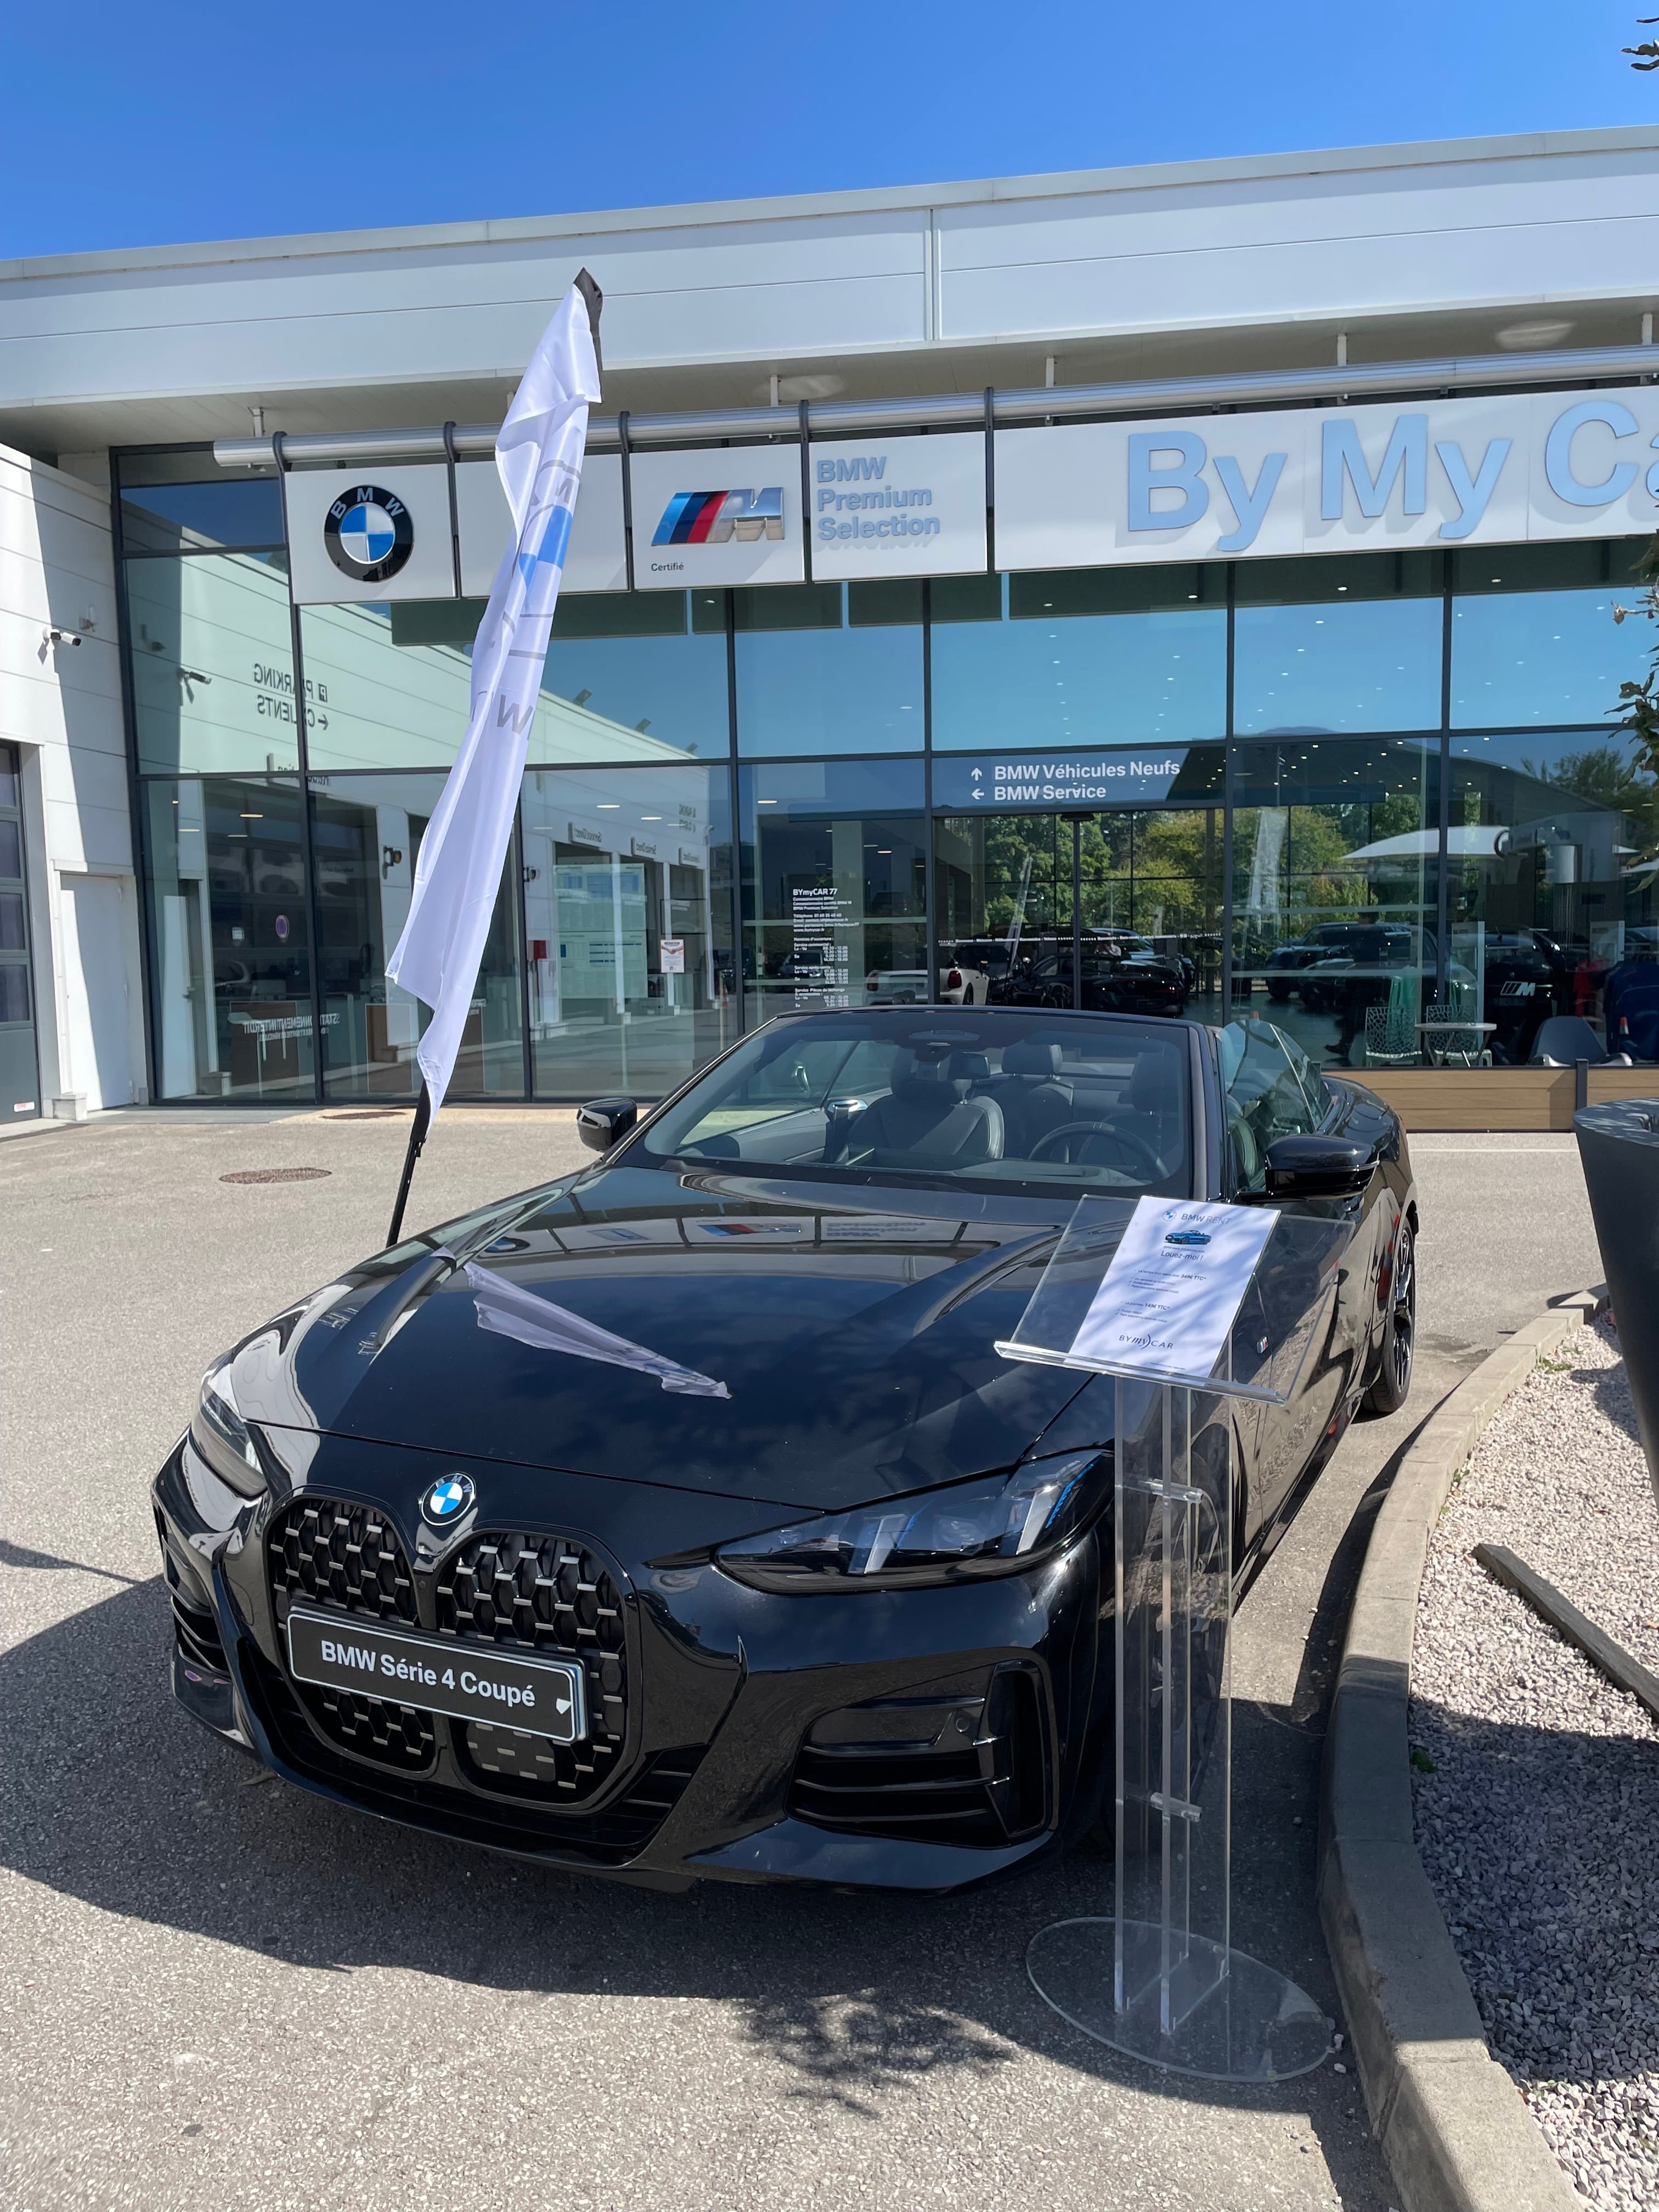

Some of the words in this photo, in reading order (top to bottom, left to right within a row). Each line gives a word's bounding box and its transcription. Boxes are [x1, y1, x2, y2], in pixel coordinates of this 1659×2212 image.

[816, 456, 887, 483] BMW
[1127, 430, 1288, 553] By
[1321, 413, 1513, 540] My
[1544, 399, 1659, 508] C
[817, 485, 932, 512] Premium
[817, 512, 940, 541] Selection
[651, 561, 685, 572] Certifié
[994, 764, 1040, 781] BMW
[1042, 761, 1126, 780] Véhicules
[1130, 759, 1181, 777] Neufs
[994, 785, 1040, 802] BMW
[1042, 784, 1107, 800] Service
[793, 888, 828, 896] BYmyCAR
[1181, 1214, 1205, 1222] BMW
[1206, 1216, 1233, 1225] RENT
[1161, 1250, 1200, 1261] Louez-moi
[321, 1640, 376, 1671] BMW
[380, 1654, 437, 1686] Série
[442, 1668, 455, 1690] 4
[460, 1671, 536, 1707] Coupé
